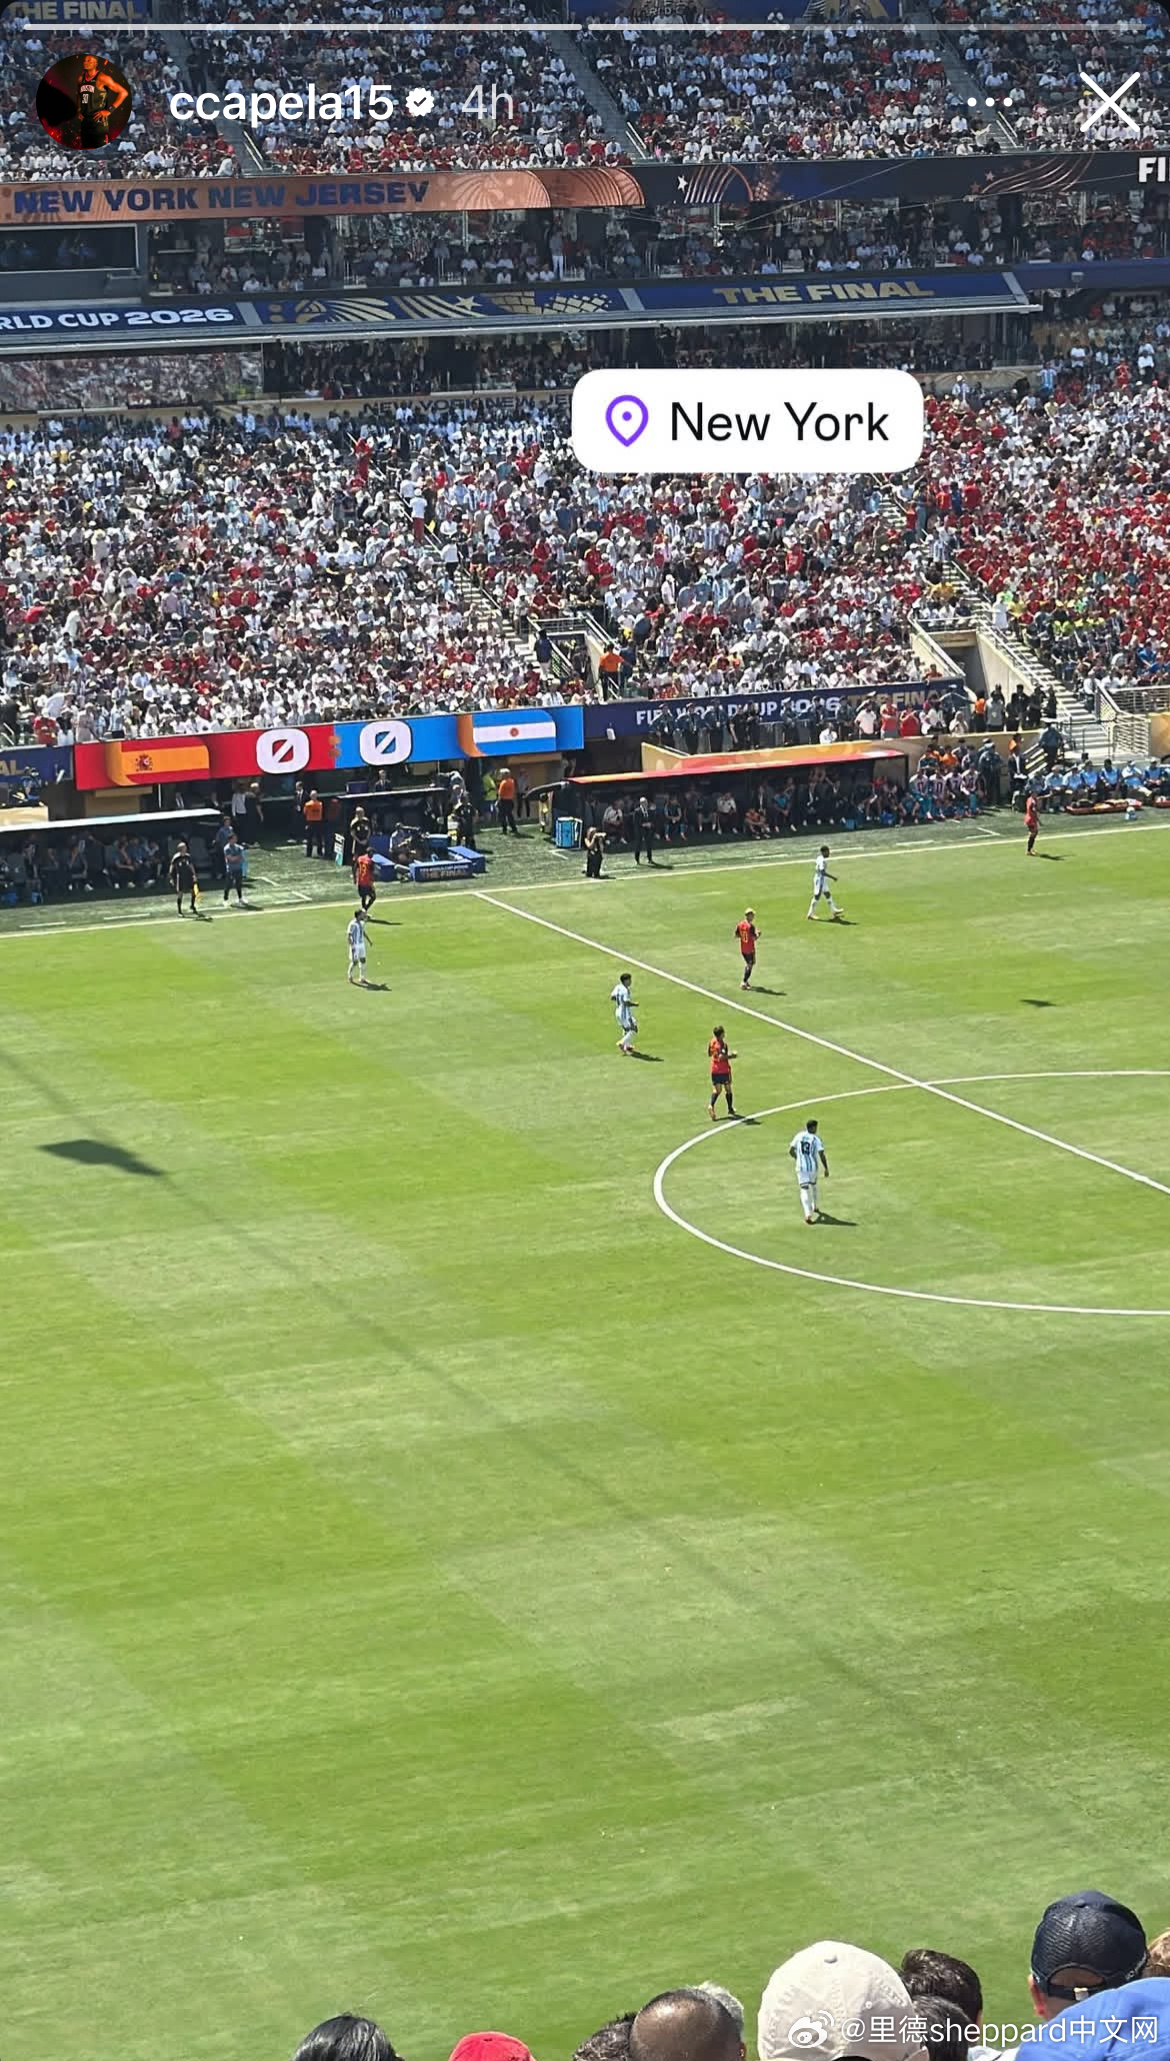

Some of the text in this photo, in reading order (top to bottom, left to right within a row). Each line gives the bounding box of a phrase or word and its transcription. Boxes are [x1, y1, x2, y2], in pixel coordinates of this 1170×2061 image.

[8, 1, 142, 19] THE FINAL
[1138, 156, 1170, 183] FI
[14, 180, 429, 214] NEW YORK NEW JERSEY
[712, 281, 935, 304] THE FINAL
[58, 312, 119, 327] CUP
[124, 308, 234, 325] 2026
